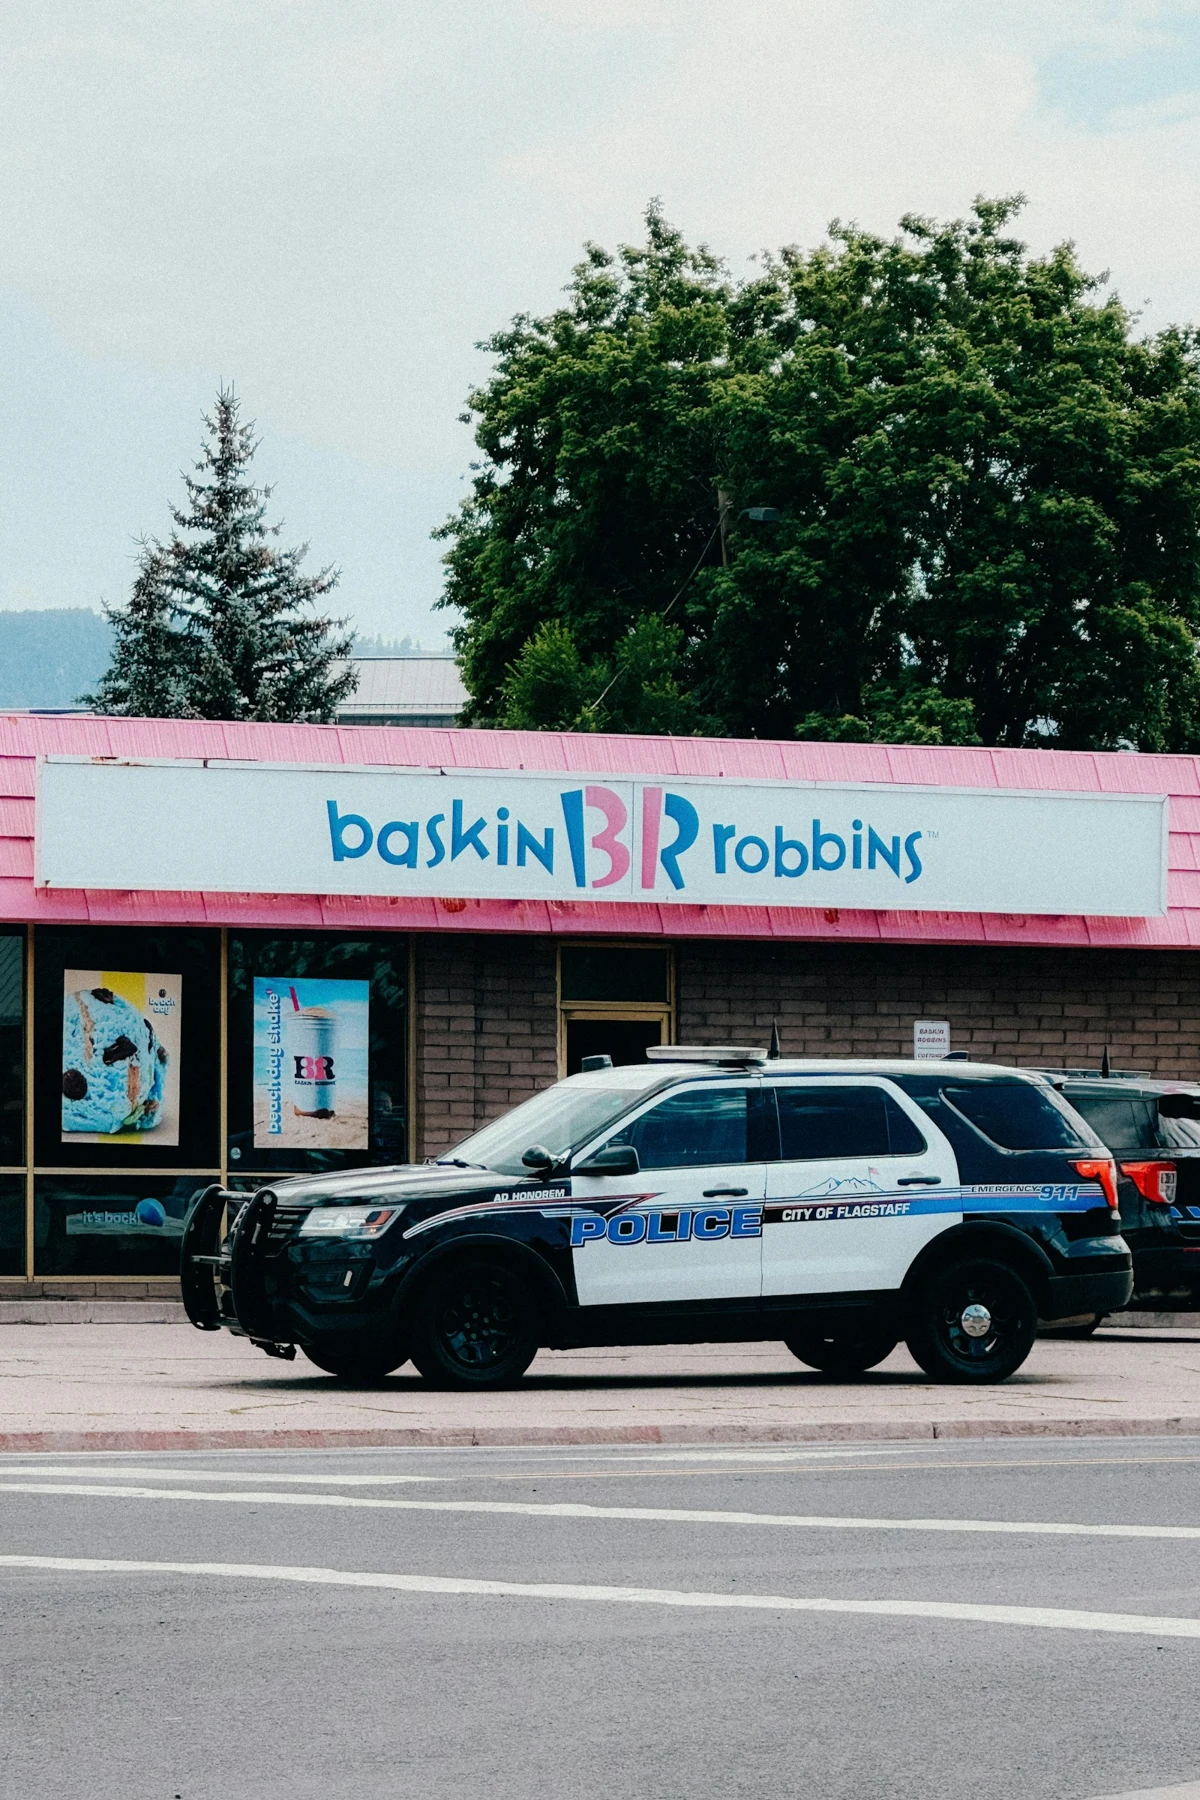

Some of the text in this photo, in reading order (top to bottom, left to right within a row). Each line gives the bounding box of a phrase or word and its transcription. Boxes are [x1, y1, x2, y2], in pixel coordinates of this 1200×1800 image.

[267, 993, 284, 1135] beach day shake
[294, 1055, 336, 1080] BR
[494, 1188, 565, 1203] AD HONOREM
[971, 1185, 1080, 1201] EMERGENCY 911
[782, 1203, 911, 1221] CITY OF FLAGSTAFF
[570, 1206, 764, 1248] POLICE
